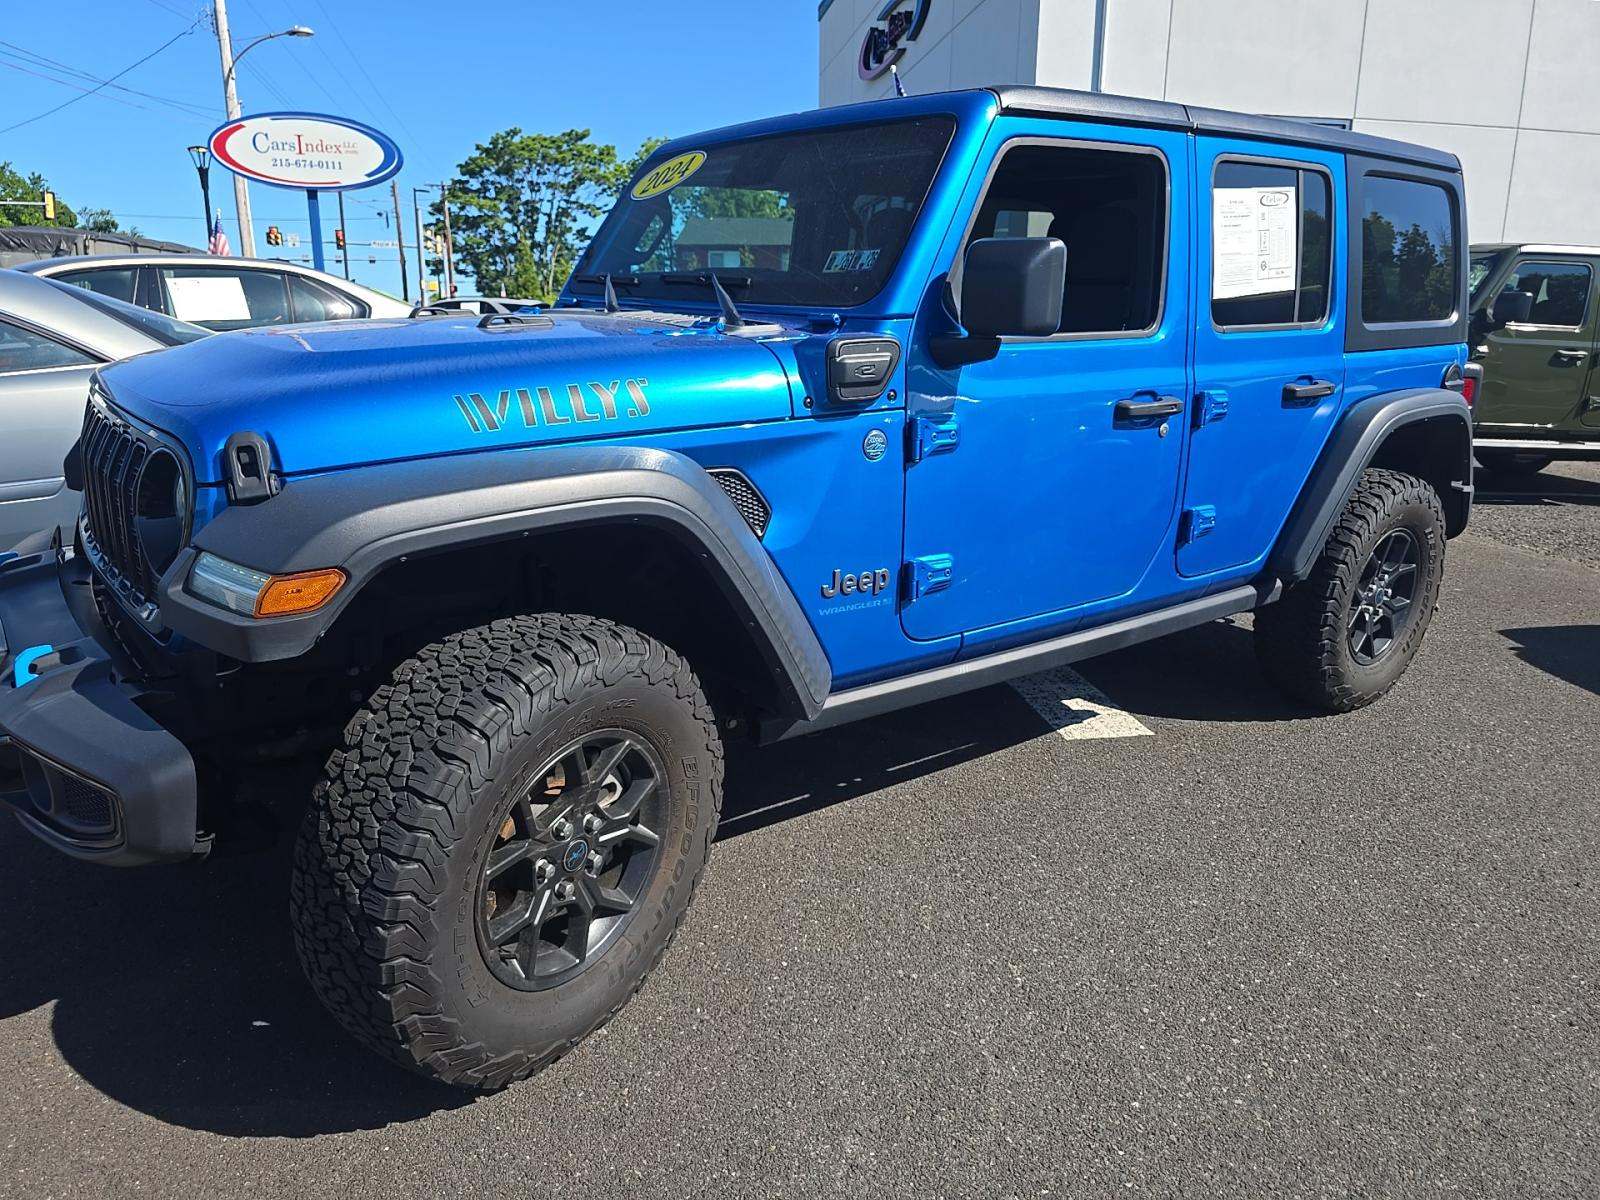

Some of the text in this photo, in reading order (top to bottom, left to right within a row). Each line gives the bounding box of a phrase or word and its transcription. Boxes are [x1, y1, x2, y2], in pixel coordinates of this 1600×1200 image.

[252, 131, 342, 155] CarsIndex
[271, 158, 343, 170] 215-674-0111
[638, 155, 698, 195] 2024
[452, 377, 651, 433] WILLYS
[821, 568, 890, 599] Jeep
[818, 600, 881, 616] WRANGLER
